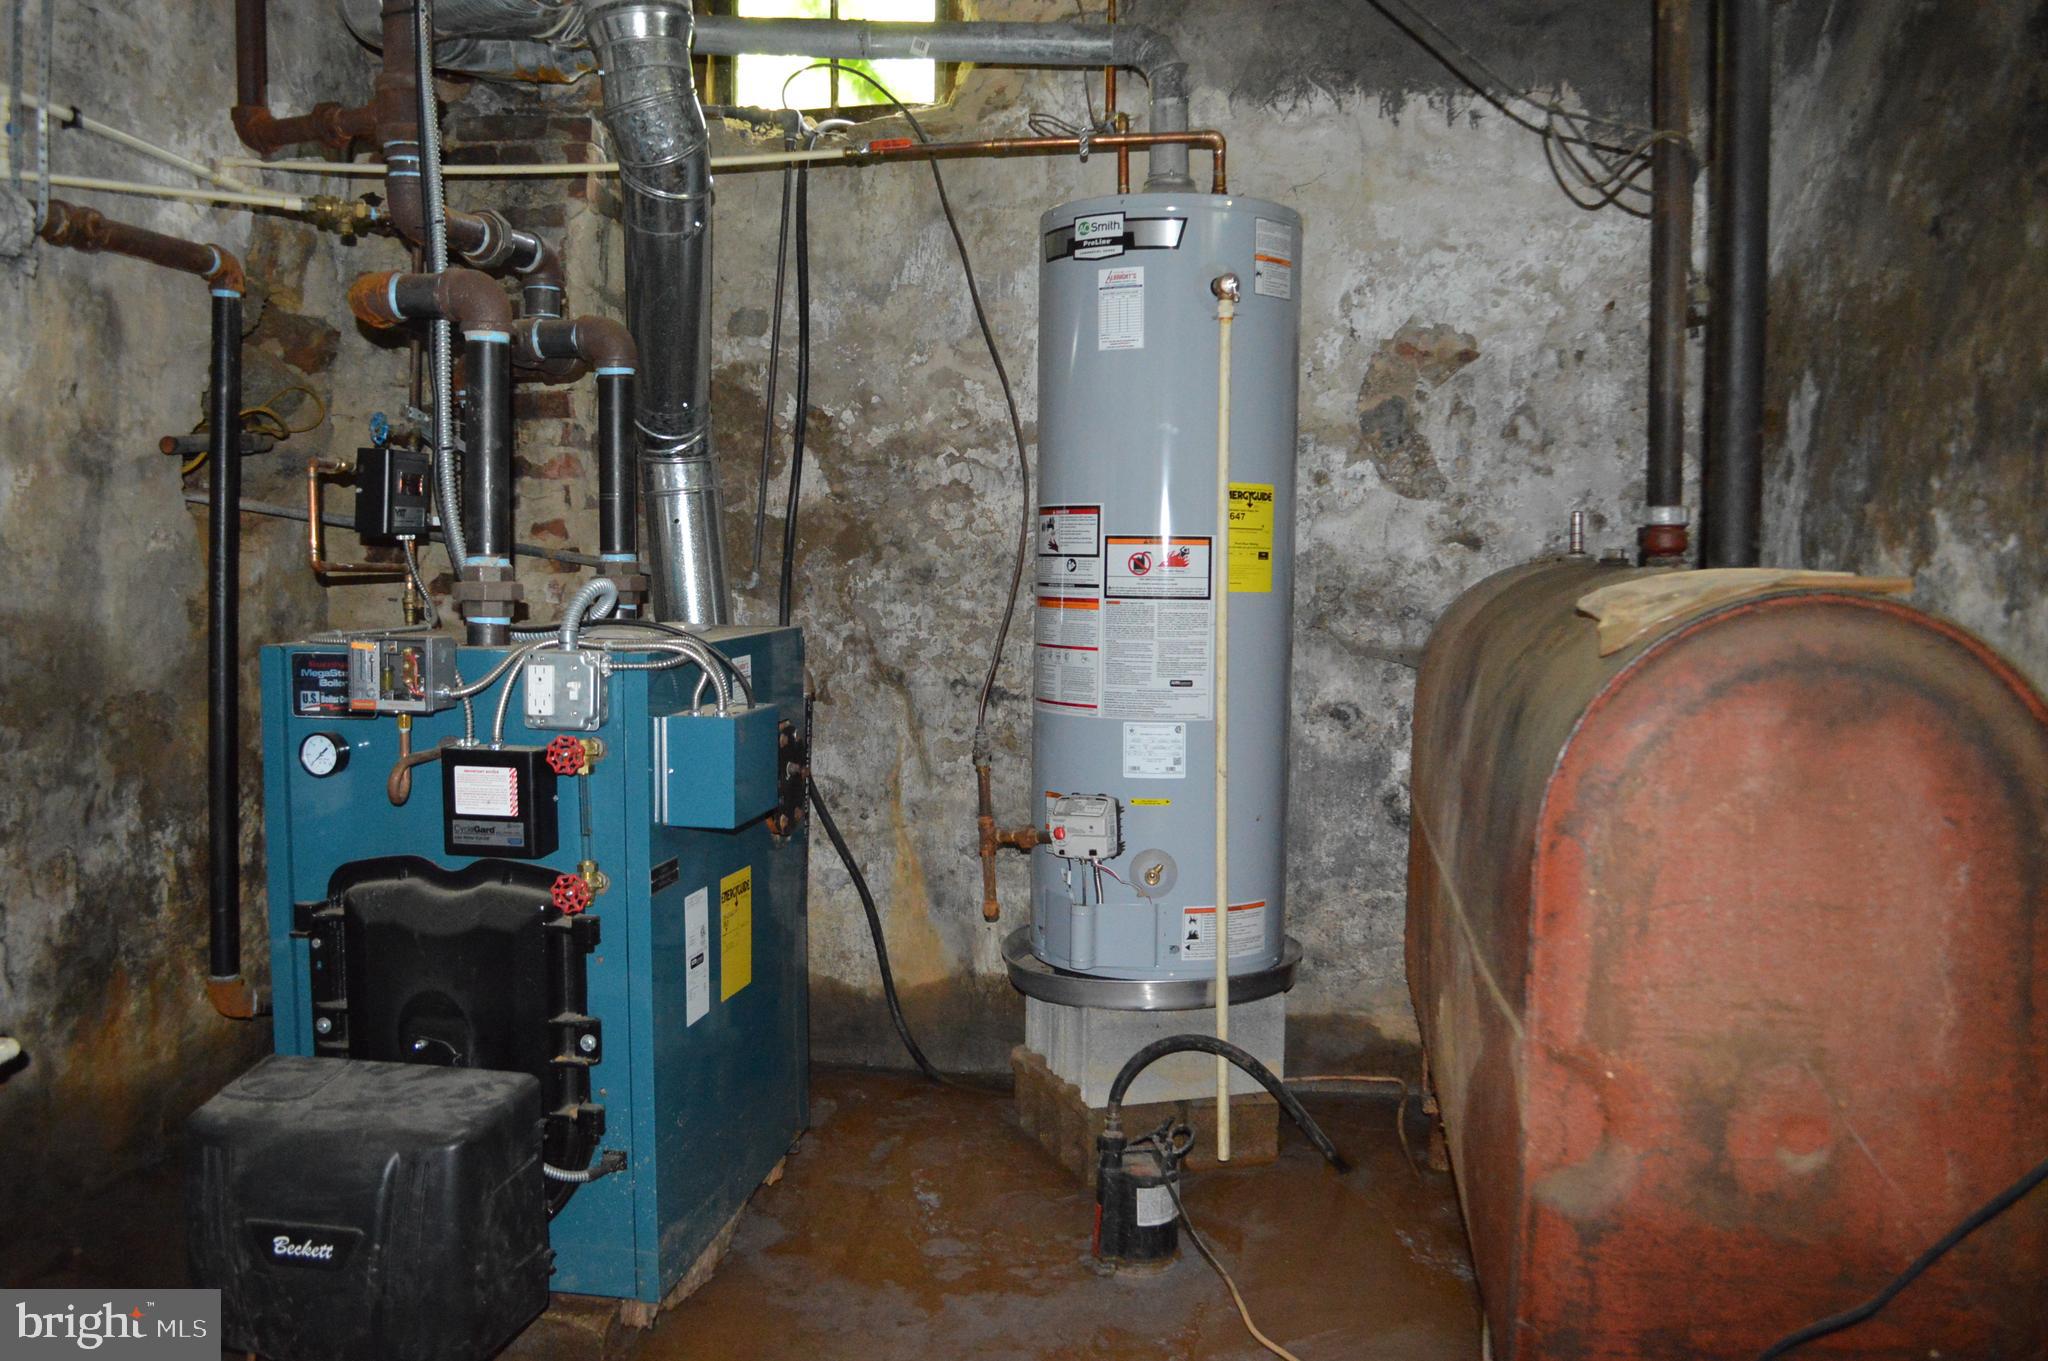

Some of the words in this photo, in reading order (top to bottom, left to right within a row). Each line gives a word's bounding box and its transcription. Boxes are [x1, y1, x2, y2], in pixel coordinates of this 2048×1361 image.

[1091, 220, 1120, 232] Smith
[1083, 238, 1112, 247] ProLine
[300, 668, 348, 678] MegaSte
[319, 678, 349, 687] Boiler
[273, 1235, 334, 1260] Beckett
